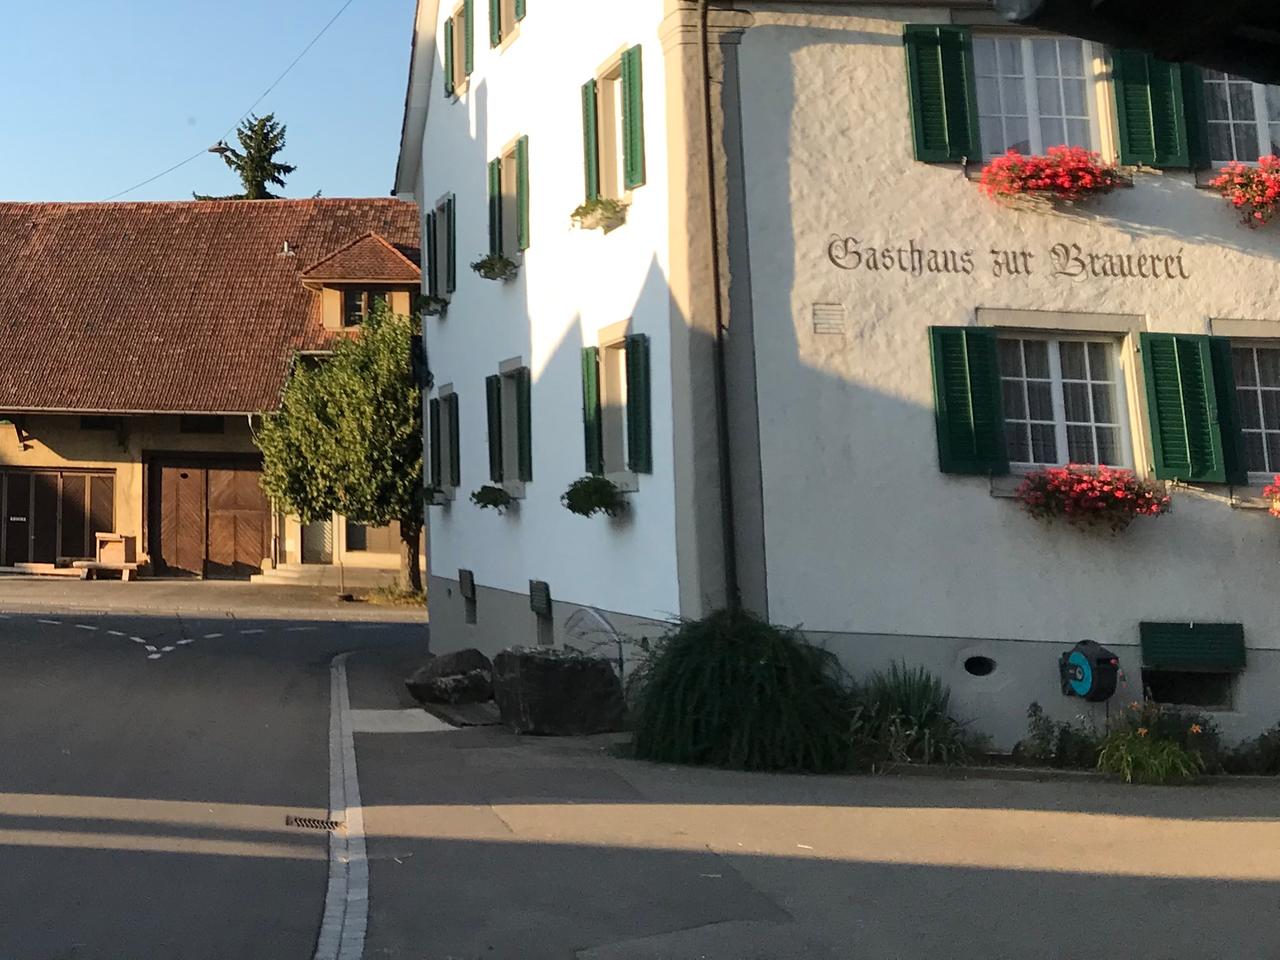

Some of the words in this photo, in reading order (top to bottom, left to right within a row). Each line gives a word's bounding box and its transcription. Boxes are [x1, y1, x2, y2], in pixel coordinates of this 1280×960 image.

[827, 234, 974, 277] Gasthaus
[990, 248, 1034, 277] zur
[1050, 242, 1190, 281] Brauerei
